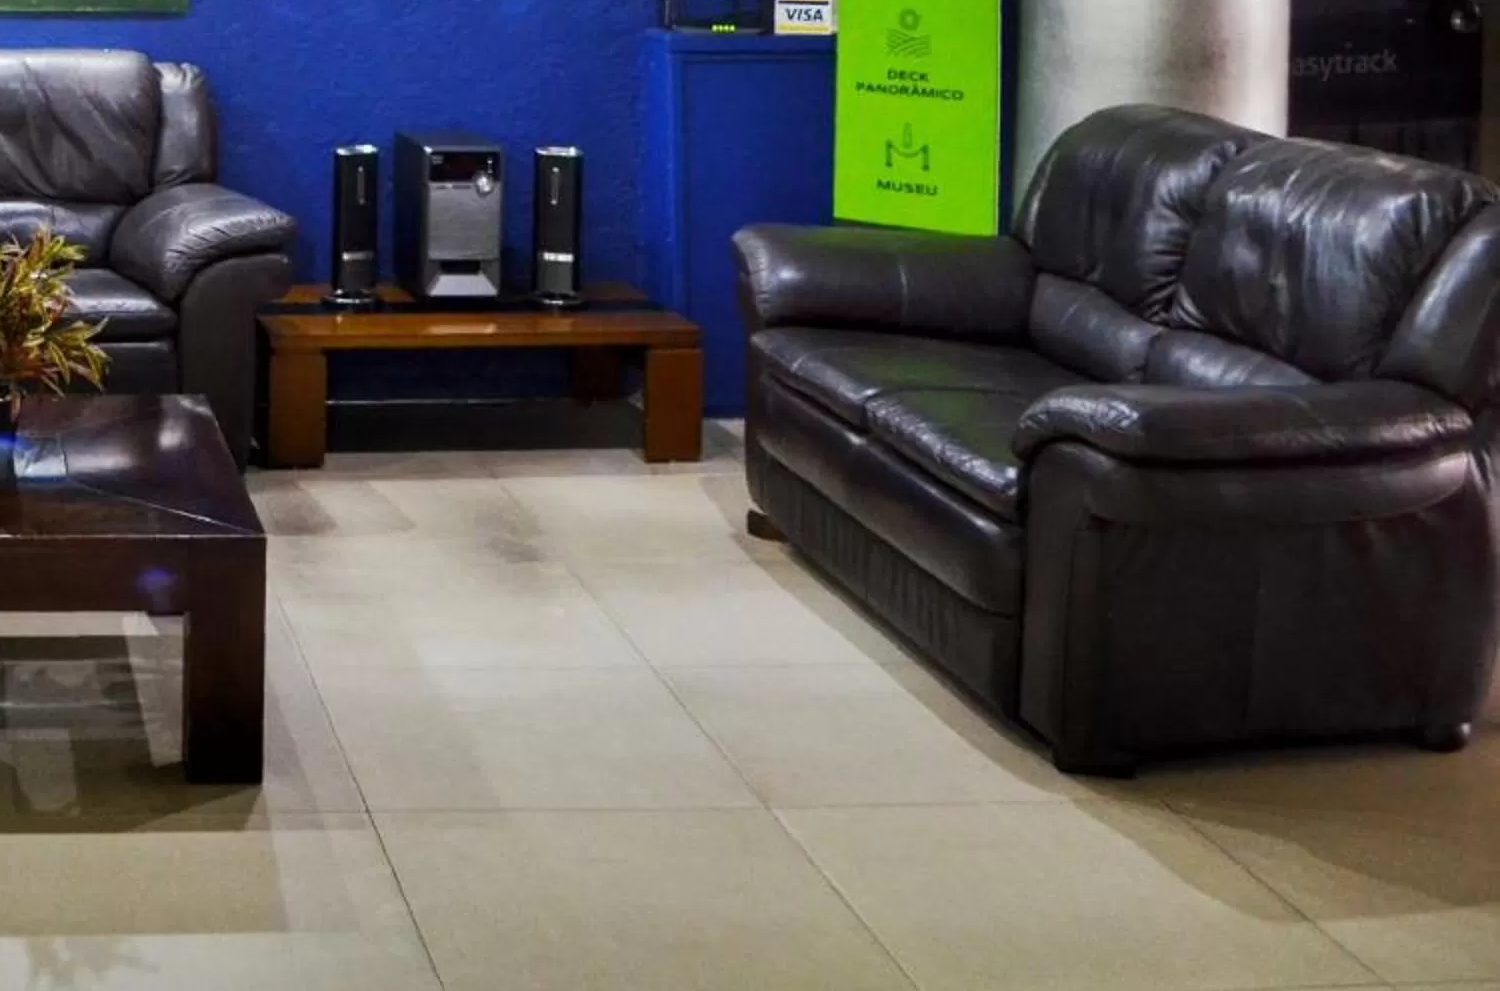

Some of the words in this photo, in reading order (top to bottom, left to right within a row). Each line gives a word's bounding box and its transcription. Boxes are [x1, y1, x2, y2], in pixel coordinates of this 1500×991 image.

[785, 8, 824, 22] VISA
[886, 69, 929, 82] DECK
[855, 81, 965, 101] PANORÂMICO
[875, 178, 938, 196] MUSEU
